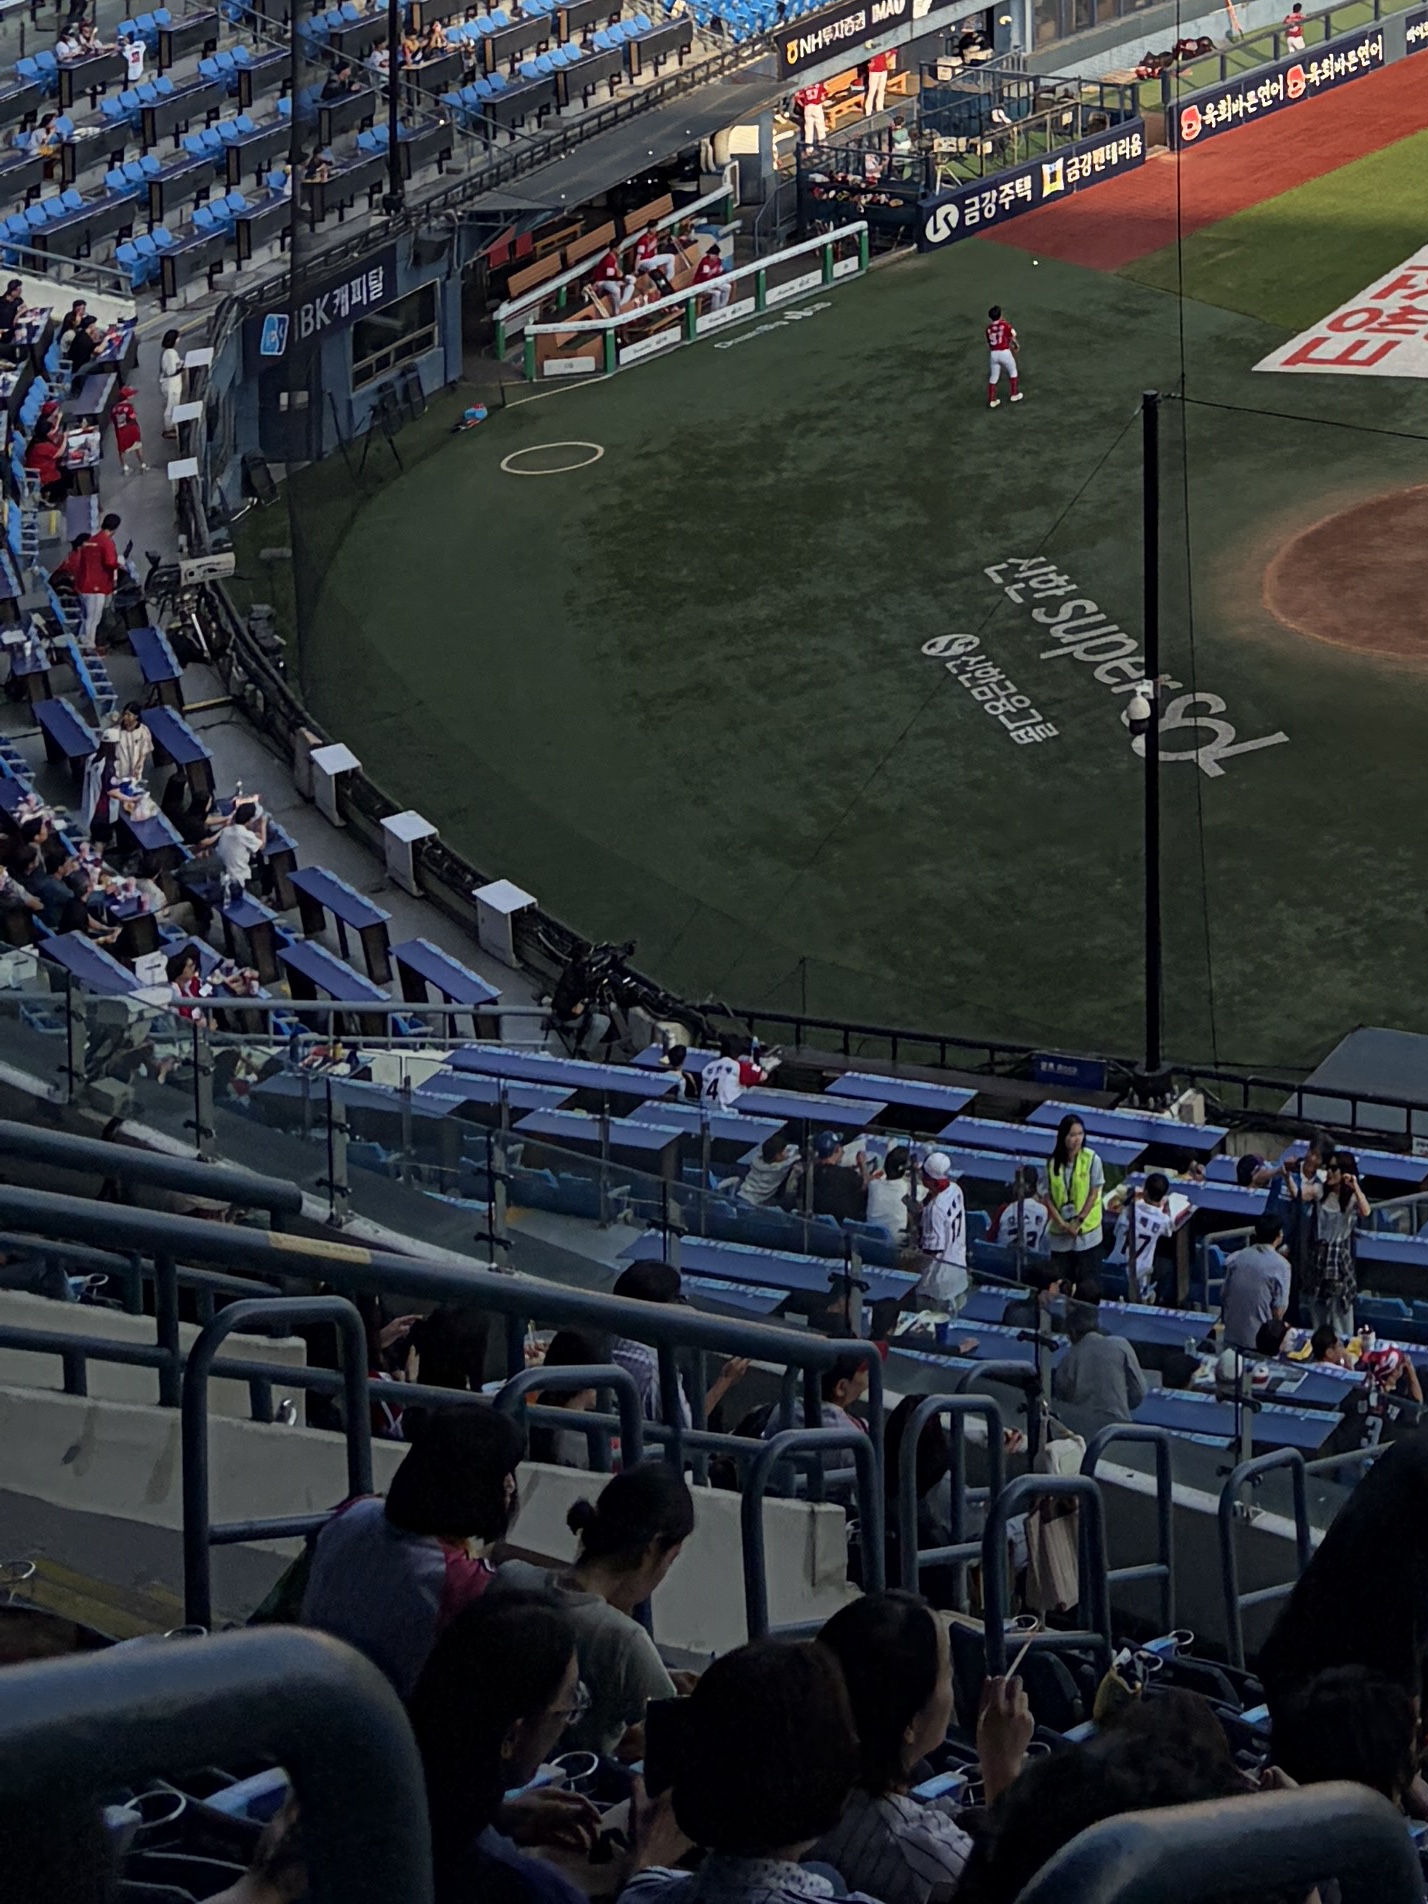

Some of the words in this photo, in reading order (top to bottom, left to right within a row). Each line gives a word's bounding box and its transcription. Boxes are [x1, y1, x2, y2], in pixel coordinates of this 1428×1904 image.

[964, 175, 1032, 226] 금강주택
[333, 265, 384, 318] 캐피탈
[983, 555, 1079, 604] 신한
[945, 654, 1060, 746] 신한금융그룹
